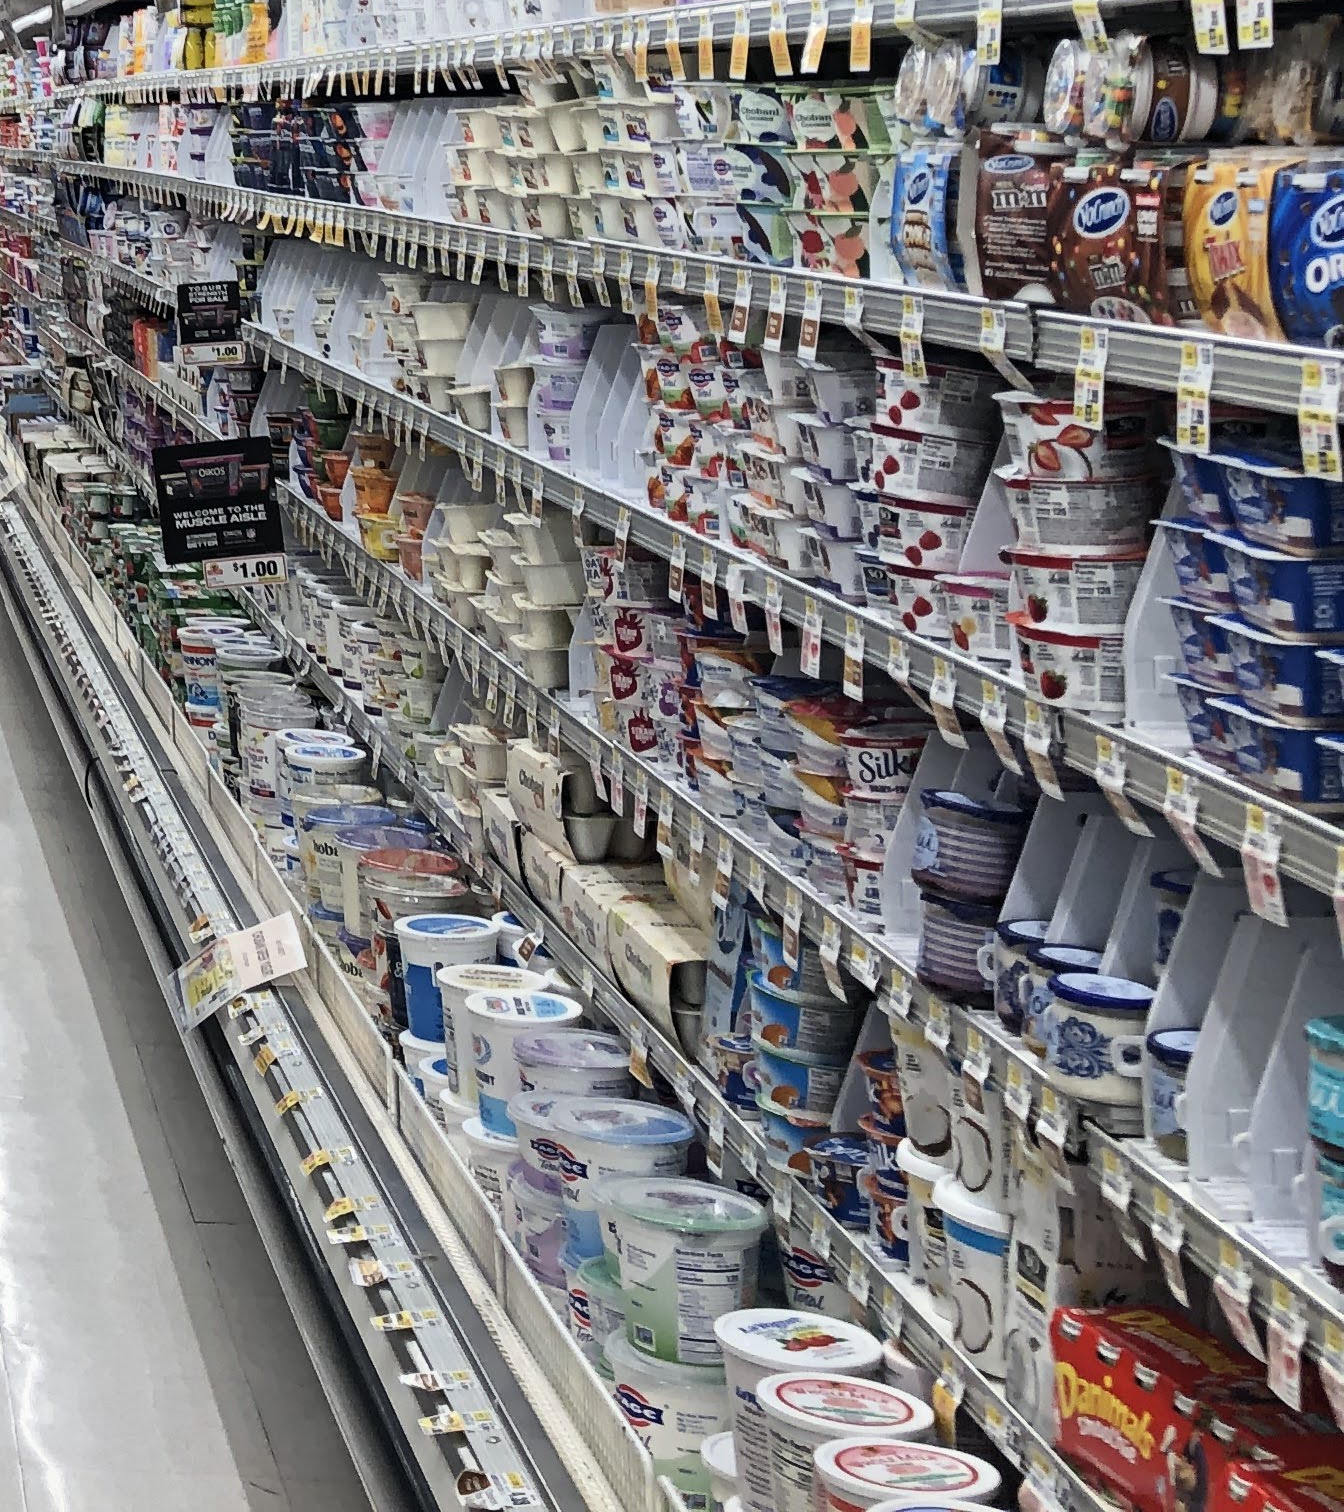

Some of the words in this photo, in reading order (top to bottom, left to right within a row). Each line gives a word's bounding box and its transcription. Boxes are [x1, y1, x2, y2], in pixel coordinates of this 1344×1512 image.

[213, 346, 237, 356] $1.00
[199, 466, 225, 477] OIKOS
[174, 508, 224, 520] WELCOME
[243, 503, 265, 511] THE
[175, 516, 227, 529] MUSCLE
[229, 512, 267, 525] AISLE
[233, 561, 278, 579] $1.00
[858, 748, 910, 784] Silk
[1055, 1361, 1156, 1462] Danimals
